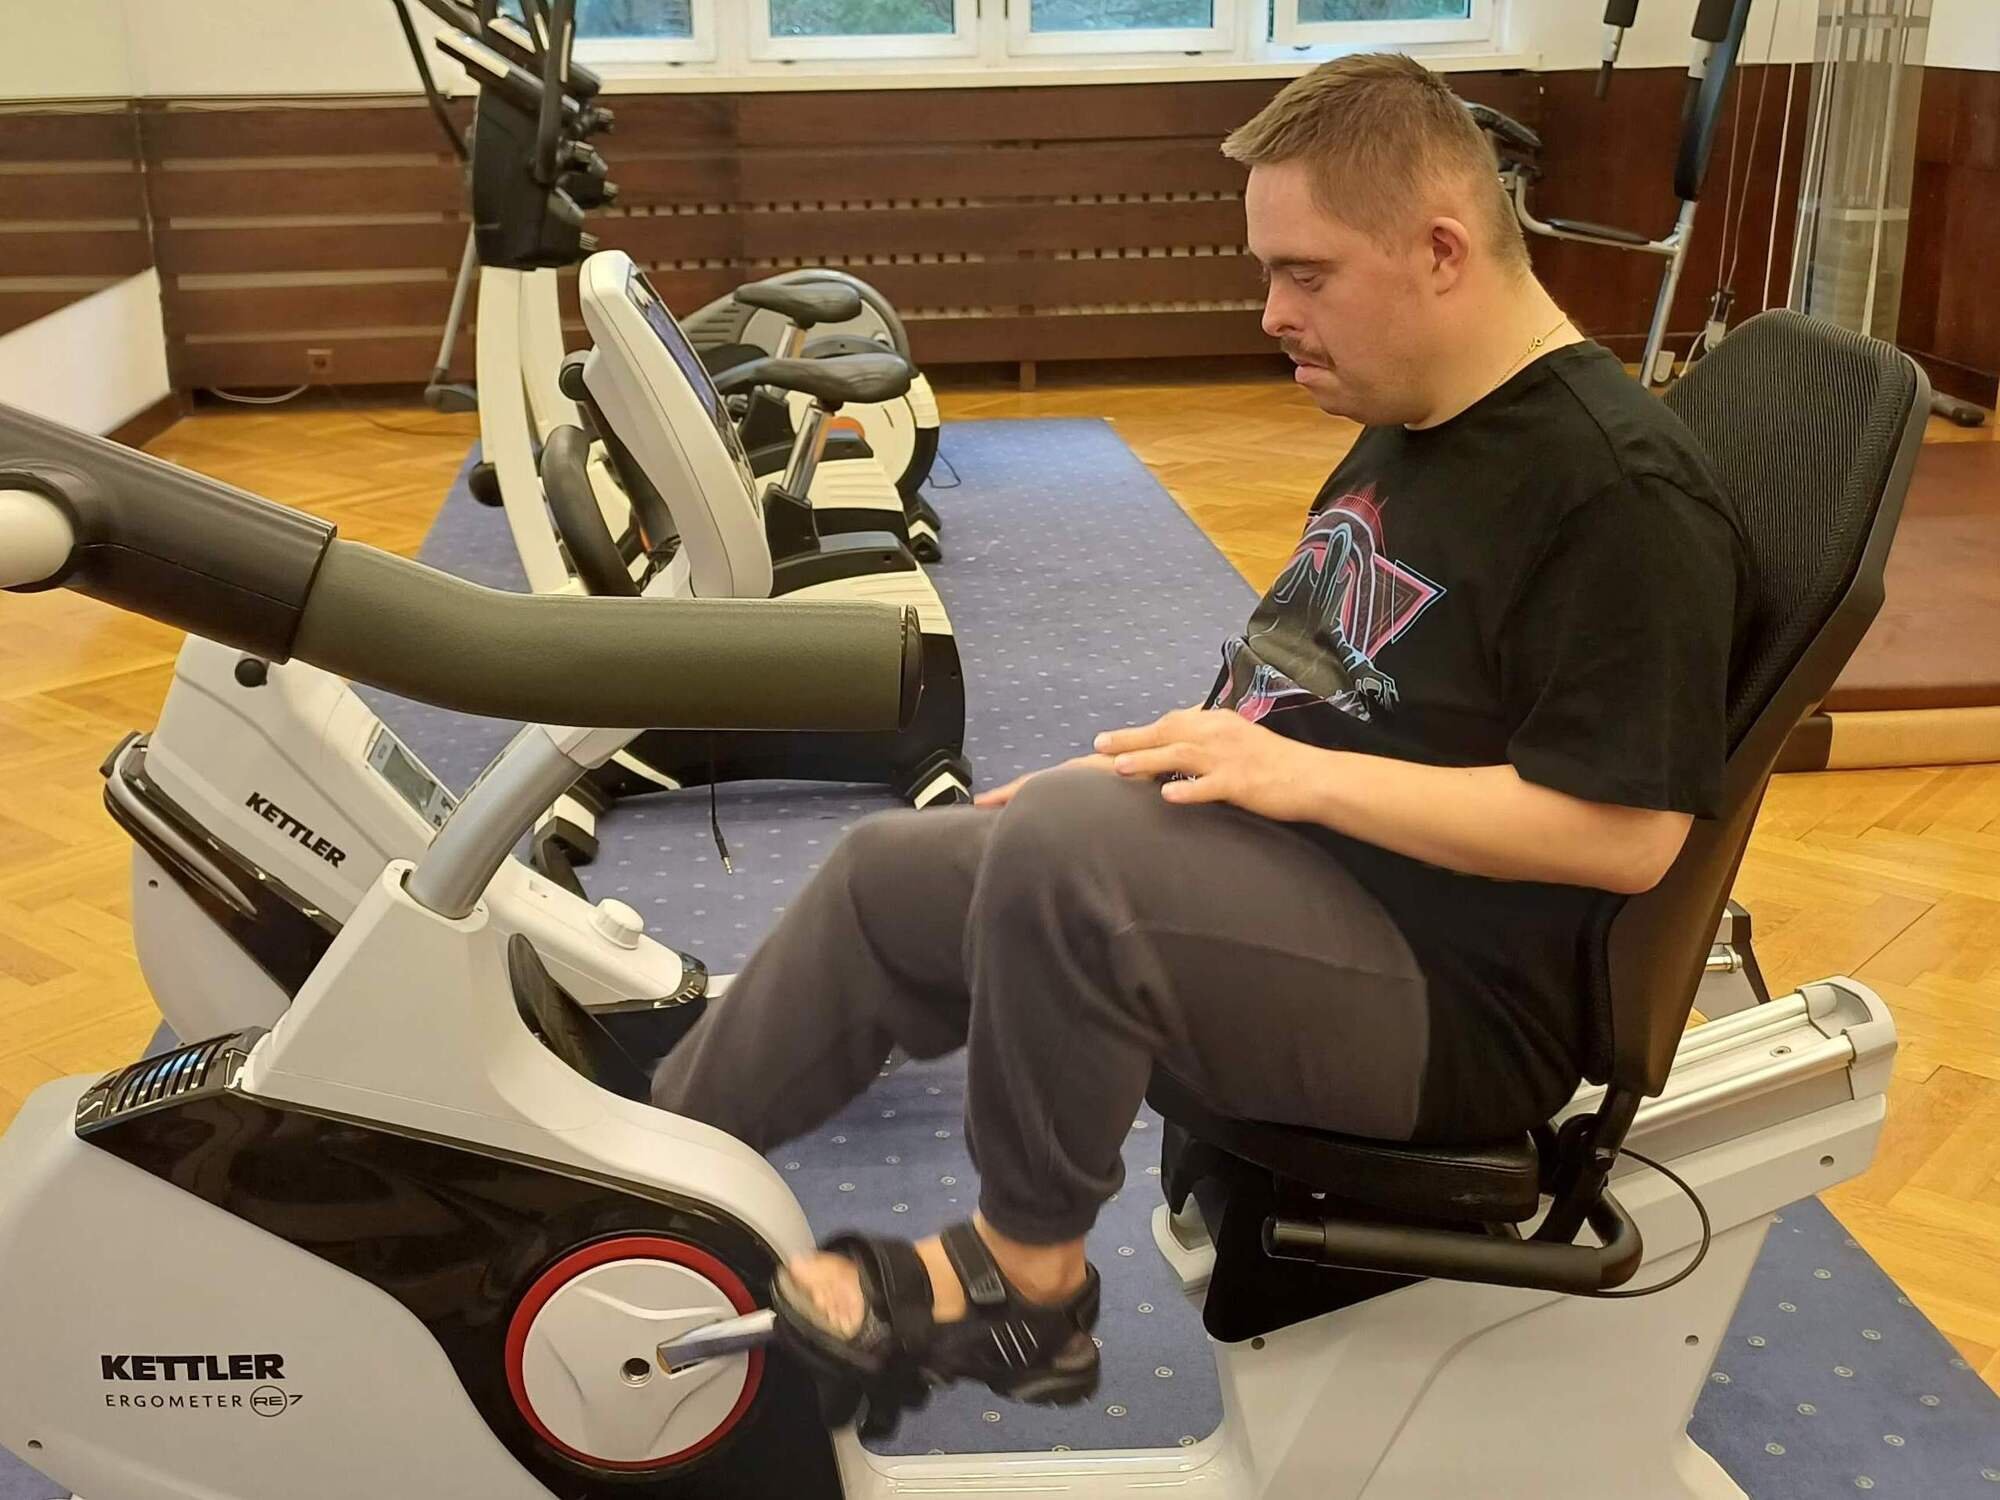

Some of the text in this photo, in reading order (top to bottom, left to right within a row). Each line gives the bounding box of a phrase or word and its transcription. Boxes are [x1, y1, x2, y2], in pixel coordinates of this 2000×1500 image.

[245, 792, 346, 868] KETTLER
[101, 1354, 285, 1380] KETTLER
[106, 1394, 242, 1408] ERGOMETER
